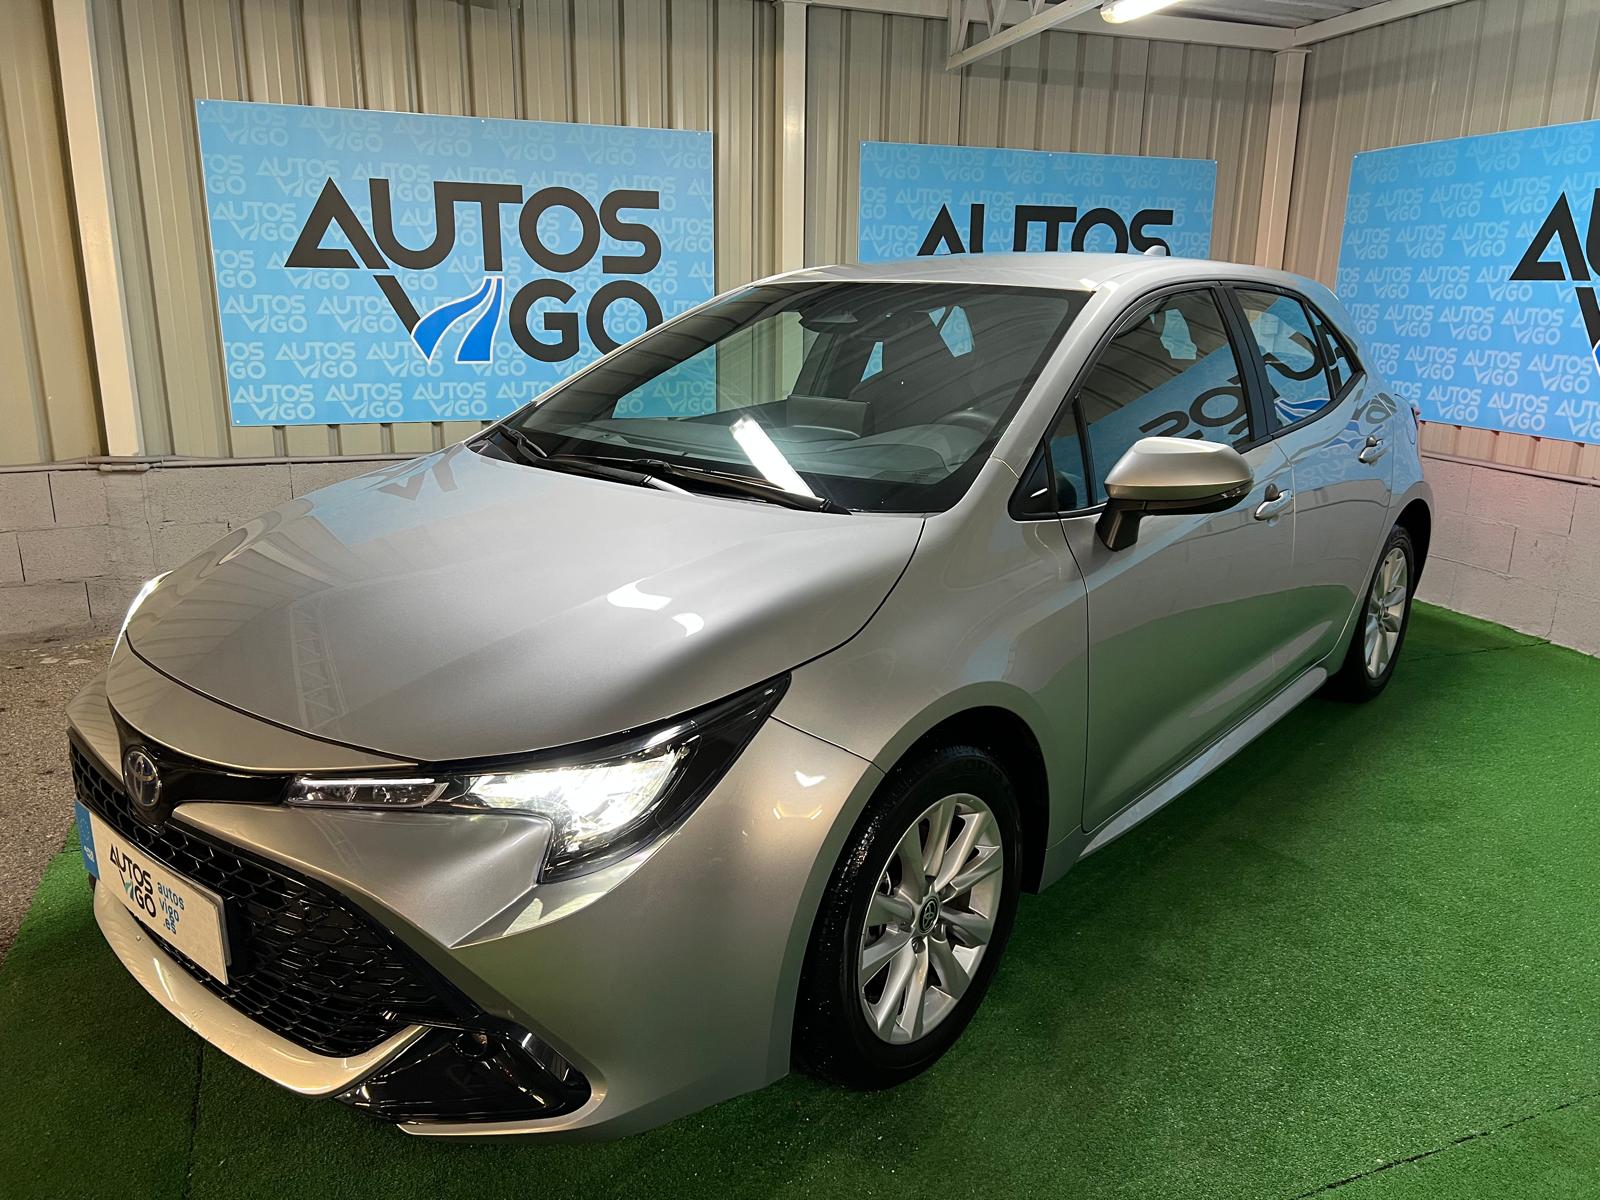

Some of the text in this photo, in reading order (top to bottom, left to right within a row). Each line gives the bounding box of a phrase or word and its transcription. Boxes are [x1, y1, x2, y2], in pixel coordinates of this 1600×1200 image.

[199, 104, 713, 151] AUTOS AUTOS AUTOS AUTOS AUTOS AUTOS
[255, 156, 340, 178] AUTOS
[350, 161, 431, 182] AUTOS
[526, 170, 598, 189] AUTOS
[895, 189, 951, 204] AUTOS
[960, 191, 1014, 206] AUTOS
[1375, 187, 1424, 206] AUTOS
[1429, 182, 1484, 202] AUTOS
[1489, 175, 1551, 197] AUTOS
[211, 203, 298, 223] AUTOS
[285, 176, 662, 274] AUTOS
[861, 226, 918, 240] AUTOS
[1345, 229, 1391, 245] AUTOS
[1396, 226, 1447, 243] AUTOS
[1452, 222, 1509, 241] AUTOS
[1364, 267, 1412, 282] AUTOS
[1417, 266, 1471, 282] AUTOS
[221, 296, 307, 314] AUTOS
[1384, 305, 1434, 321] AUTOS
[1440, 306, 1495, 324] AUTOS
[1501, 308, 1564, 327] AUTOS
[274, 341, 356, 358] AUTOS
[1405, 344, 1457, 362] AUTOS
[1463, 348, 1521, 368] AUTOS
[1528, 352, 1594, 374] AUTOS
[231, 385, 314, 403] AUTOS
[324, 383, 403, 401] AUTOS
[412, 382, 486, 400] AUTOS
[1427, 385, 1481, 405] AUTOS
[1487, 391, 1549, 414] AUTOS
[110, 844, 153, 896] AUTOS
[157, 881, 185, 911] autos
[158, 897, 180, 925] vigo
